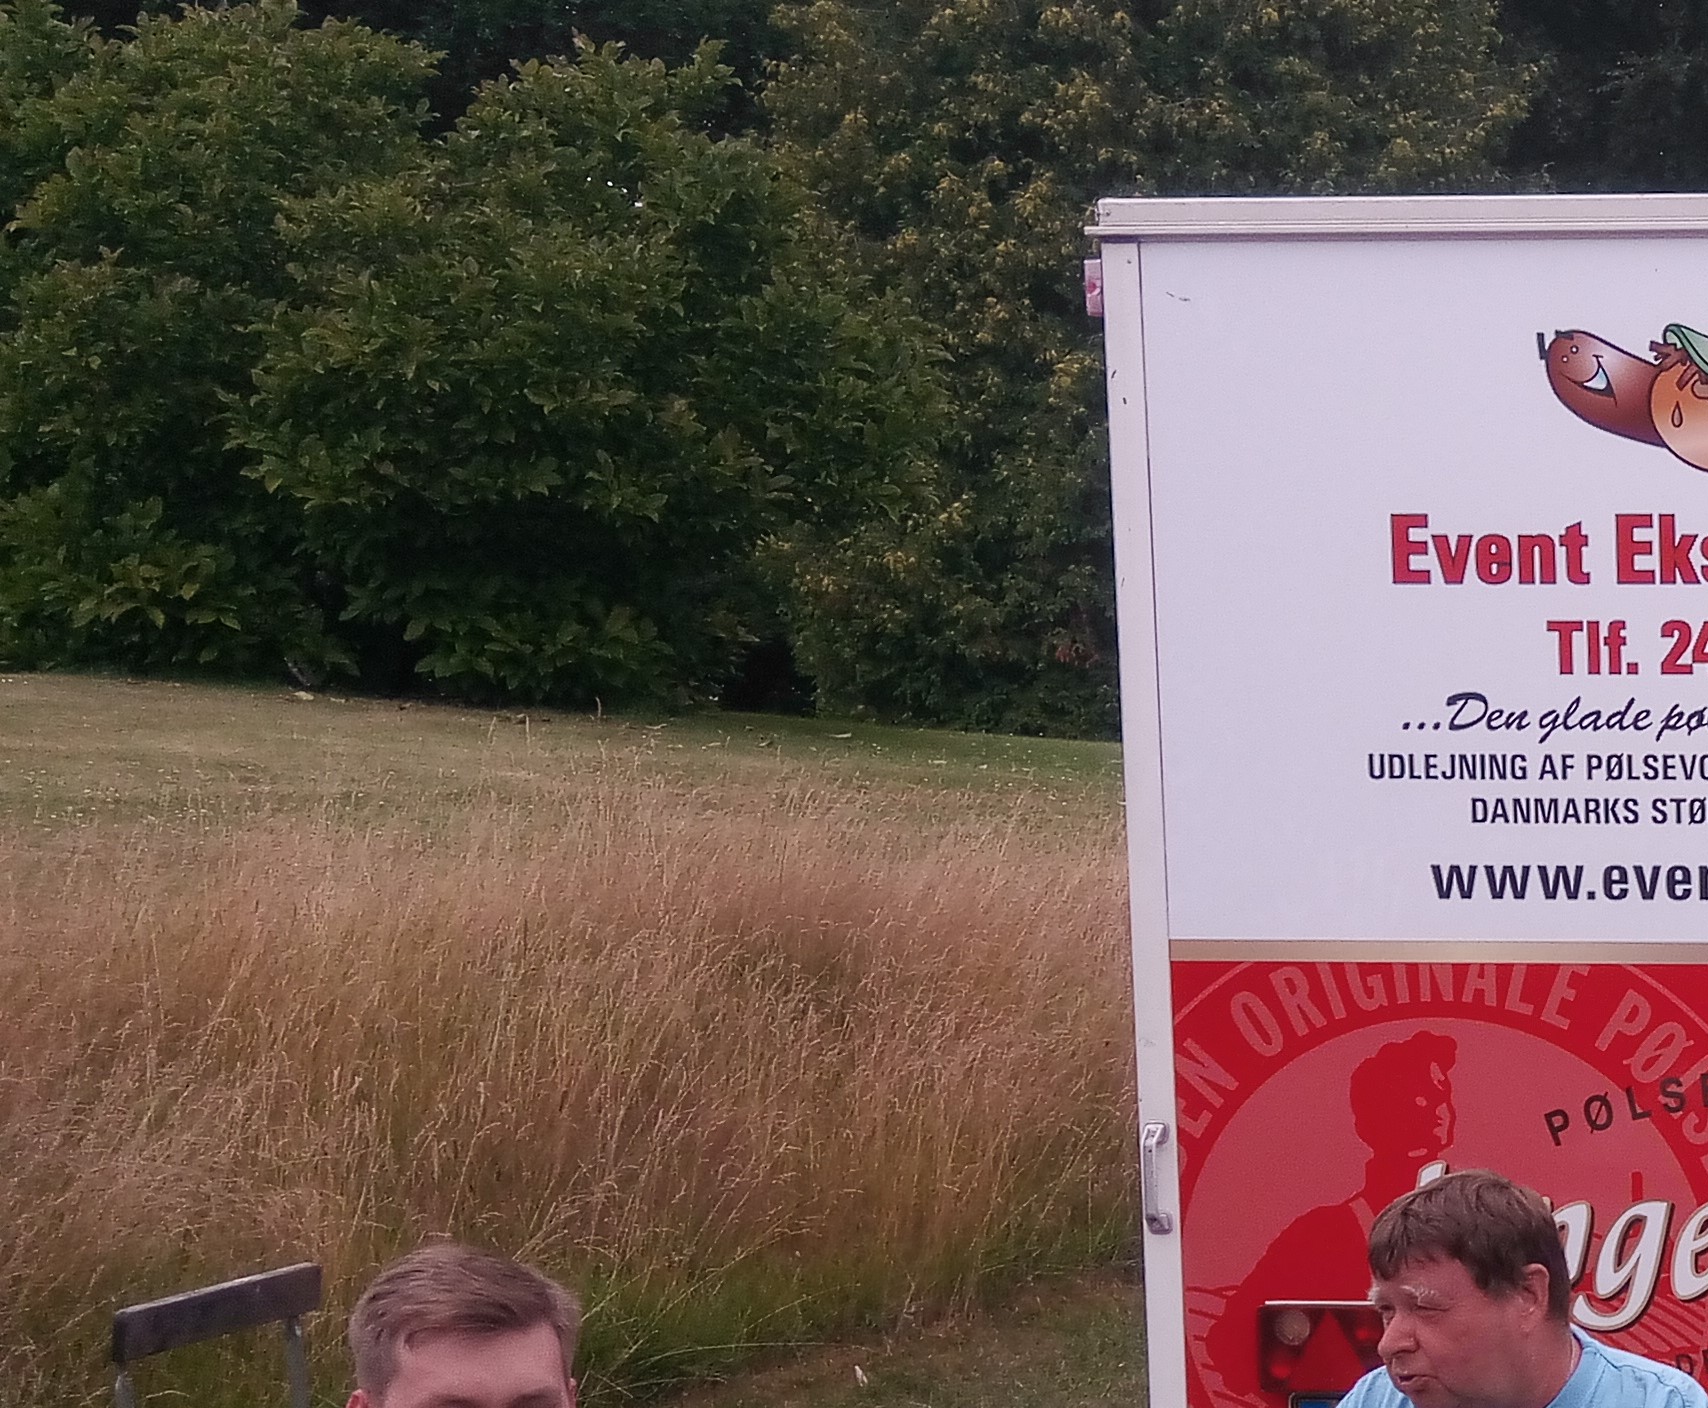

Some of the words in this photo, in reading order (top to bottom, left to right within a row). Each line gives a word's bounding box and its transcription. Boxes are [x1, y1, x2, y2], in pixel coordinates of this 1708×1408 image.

[1390, 512, 1591, 586] Event
[1546, 619, 1640, 676] Tlf.
[1401, 692, 1531, 732] ...Den
[1538, 699, 1653, 743] glade
[1367, 752, 1528, 782] UDLEJNING
[1537, 753, 1575, 781] AF
[1470, 797, 1640, 825] DANMARKS
[1230, 963, 1590, 1057] ORIGINALE
